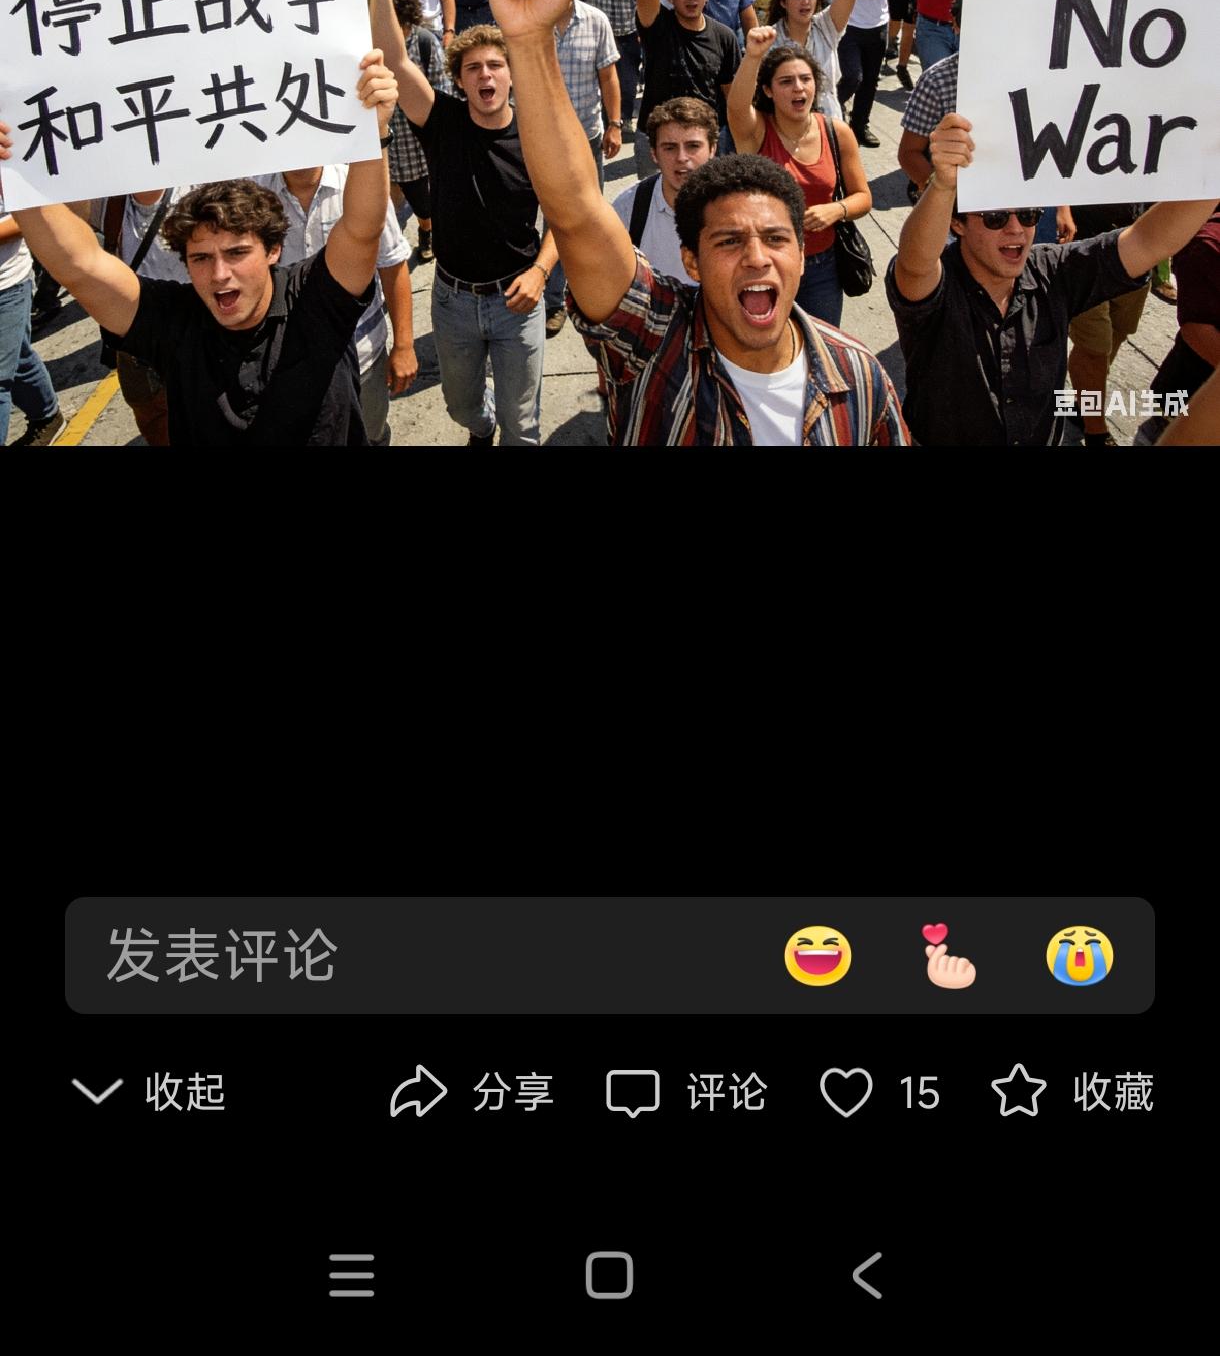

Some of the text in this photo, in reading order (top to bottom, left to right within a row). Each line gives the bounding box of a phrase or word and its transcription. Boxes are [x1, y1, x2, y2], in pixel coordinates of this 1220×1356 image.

[18, 57, 357, 176] 和平共处
[1007, 83, 1198, 182] War
[106, 927, 338, 983] 发表评论
[145, 1071, 226, 1112] 收起
[472, 1071, 554, 1112] 分享
[686, 1071, 768, 1112] 评论
[900, 1075, 940, 1110] 15
[1073, 1071, 1154, 1112] 收藏
